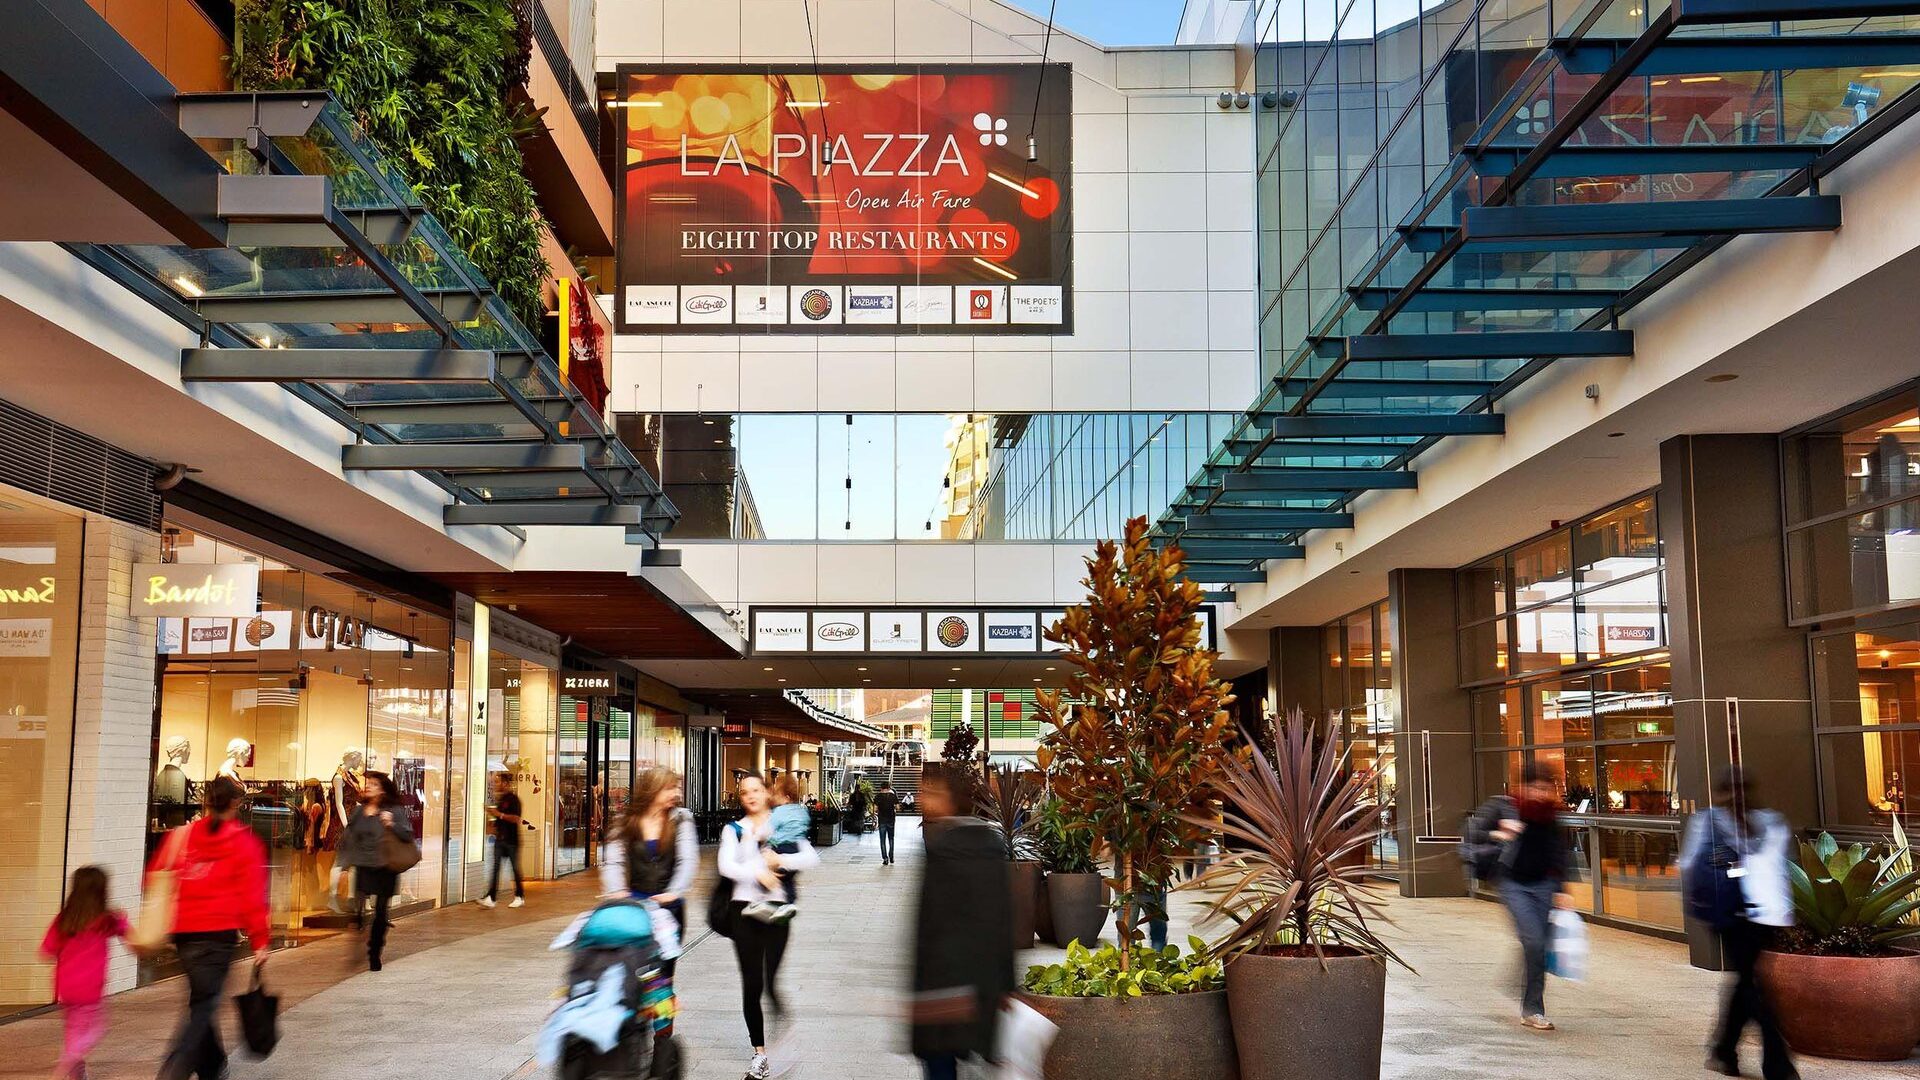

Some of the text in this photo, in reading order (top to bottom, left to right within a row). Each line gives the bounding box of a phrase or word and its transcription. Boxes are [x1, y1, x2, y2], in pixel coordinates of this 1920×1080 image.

[680, 134, 970, 177] LA PIAZZA
[846, 188, 971, 213] Open Air Fare
[681, 230, 1008, 251] EIGHT TOP RESTAURANTS
[852, 298, 879, 306] KAZBAH
[143, 574, 239, 606] Bardot
[992, 628, 1018, 636] KAZBAH
